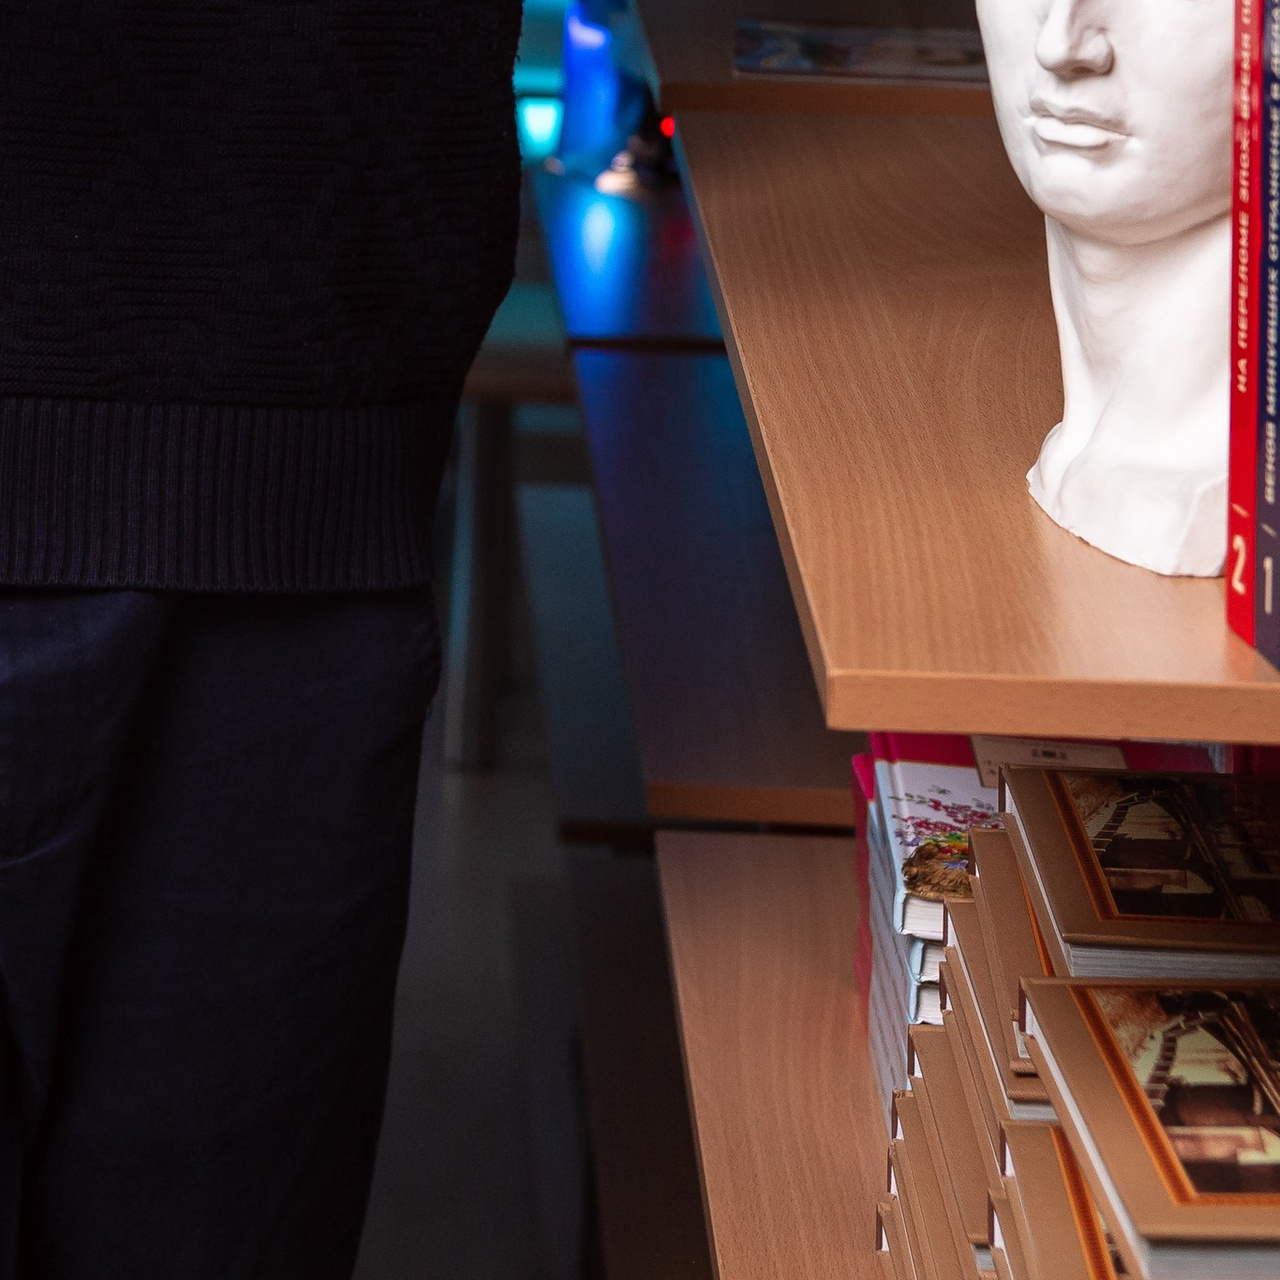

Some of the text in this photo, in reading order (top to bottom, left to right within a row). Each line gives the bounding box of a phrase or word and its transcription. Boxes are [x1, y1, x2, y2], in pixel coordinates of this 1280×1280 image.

[1240, 33, 1252, 120] ВРЕМЯ
[1270, 81, 1280, 102] В
[1268, 105, 1280, 261] ОТРАЖЕНЬЕ
[1237, 210, 1250, 349] ПЕРЕЛОМЕ
[1237, 356, 1248, 394] НА
[1266, 268, 1280, 415] МИНУВШИХ
[1264, 421, 1278, 505] ВЕКОВ
[1231, 534, 1246, 595] 2
[1263, 556, 1274, 615] 1
